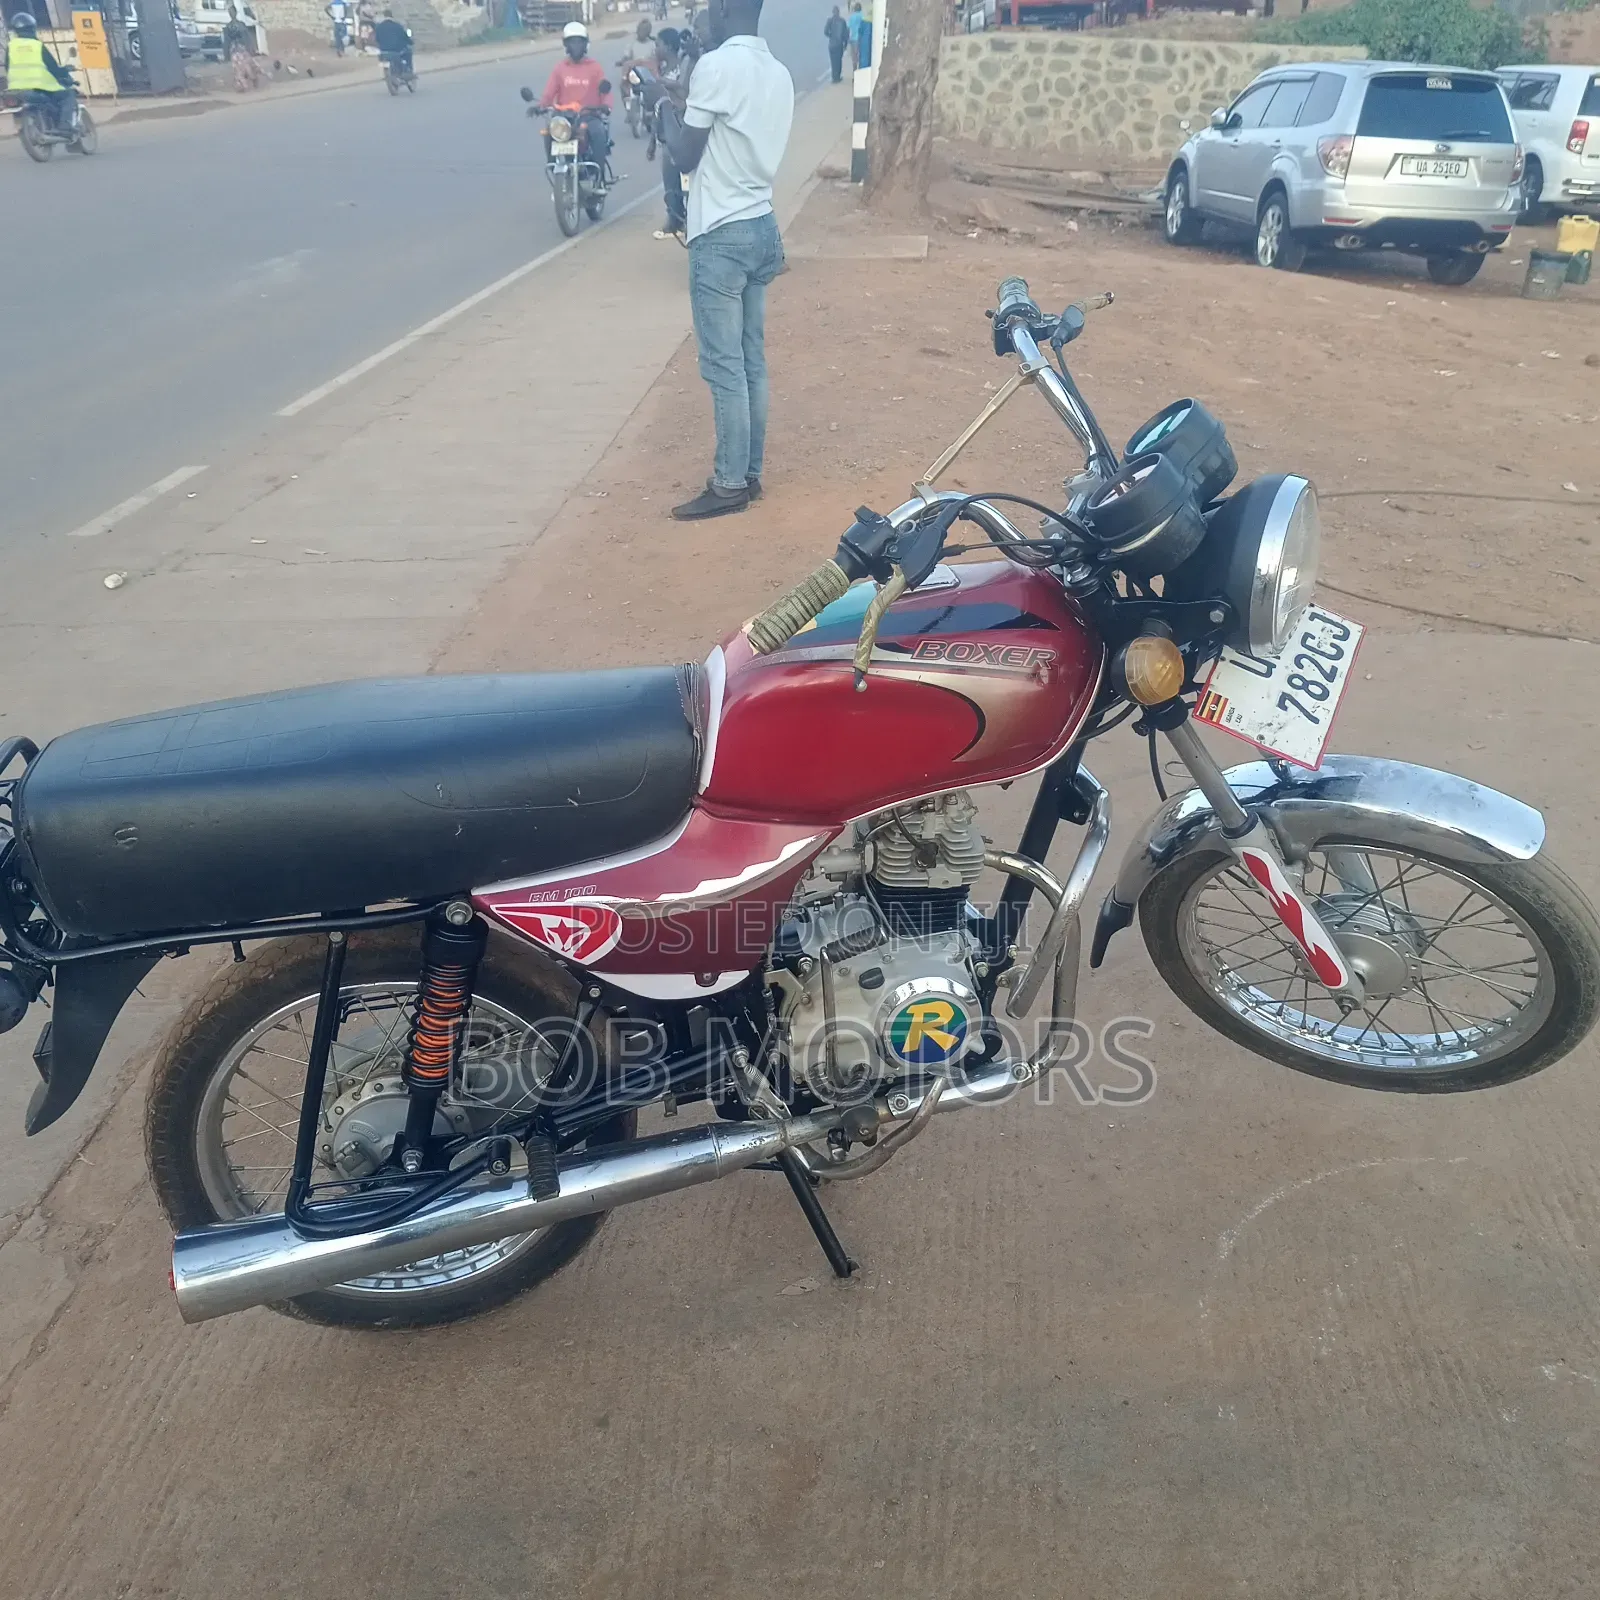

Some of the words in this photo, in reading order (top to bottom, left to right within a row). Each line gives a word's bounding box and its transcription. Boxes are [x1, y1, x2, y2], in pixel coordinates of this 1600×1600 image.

[912, 640, 1058, 669] BOXER
[1276, 611, 1351, 725] 782CJ
[528, 889, 560, 903] BM
[563, 884, 597, 900] 100
